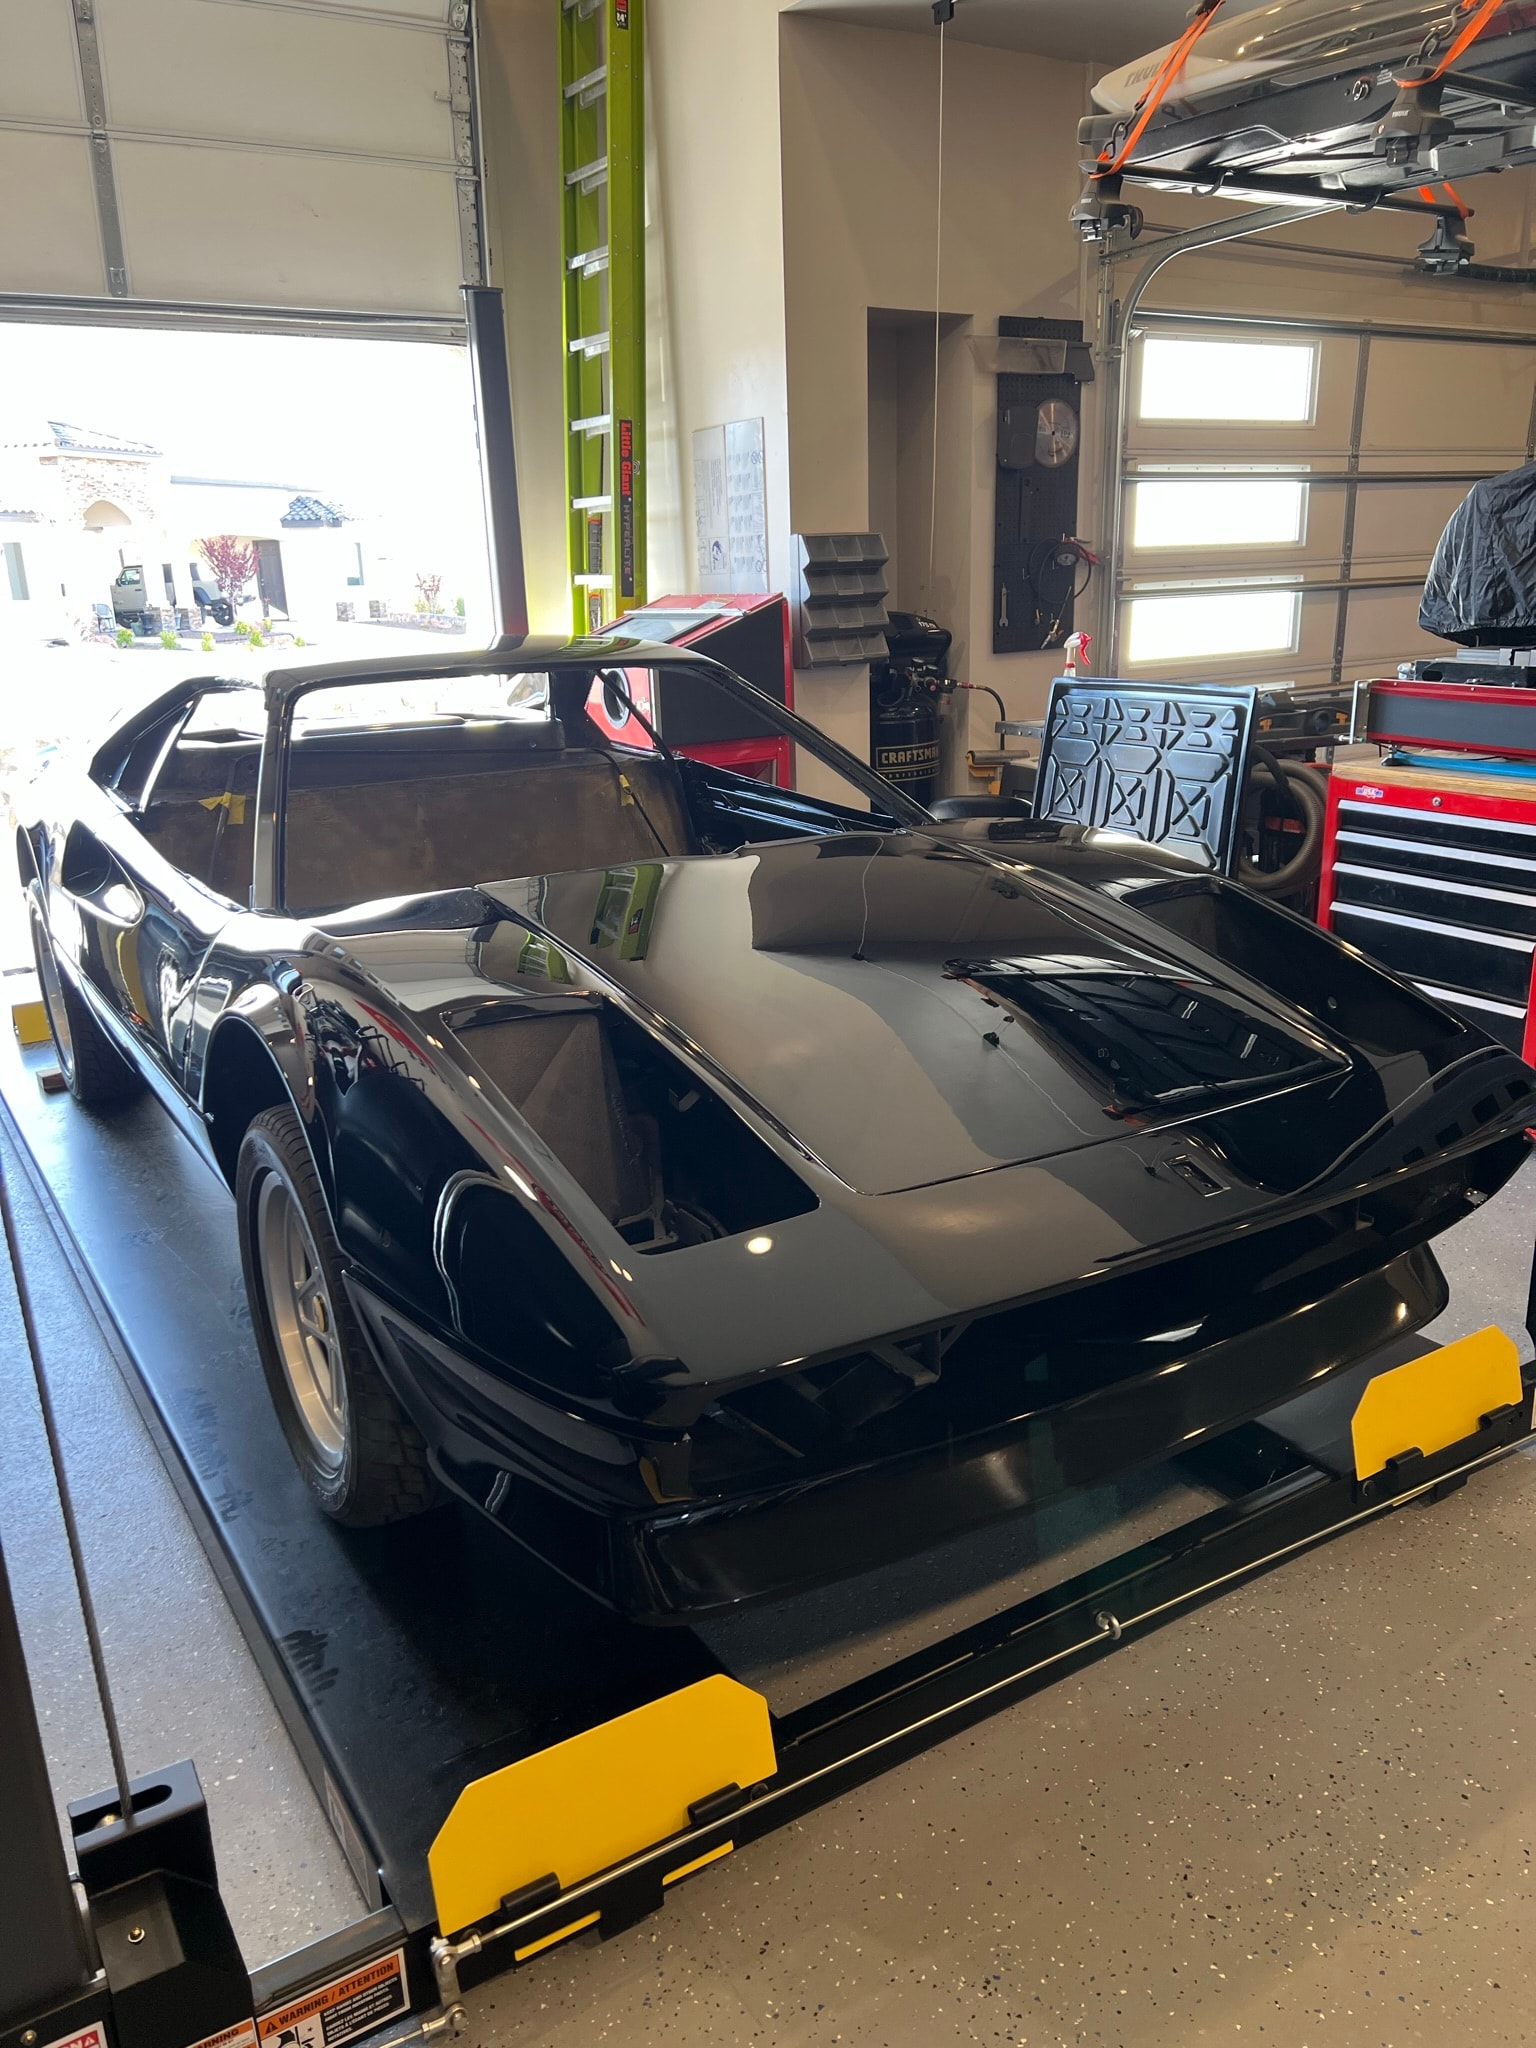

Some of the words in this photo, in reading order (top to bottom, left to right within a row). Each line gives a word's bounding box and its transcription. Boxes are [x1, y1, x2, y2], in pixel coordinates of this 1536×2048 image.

[1124, 62, 1161, 88] THUL
[621, 422, 632, 458] Little
[621, 460, 632, 496] Giant
[278, 1995, 329, 2025] WARNING
[338, 1962, 394, 1998] ATTENTION
[196, 2028, 239, 2048] ARNING
